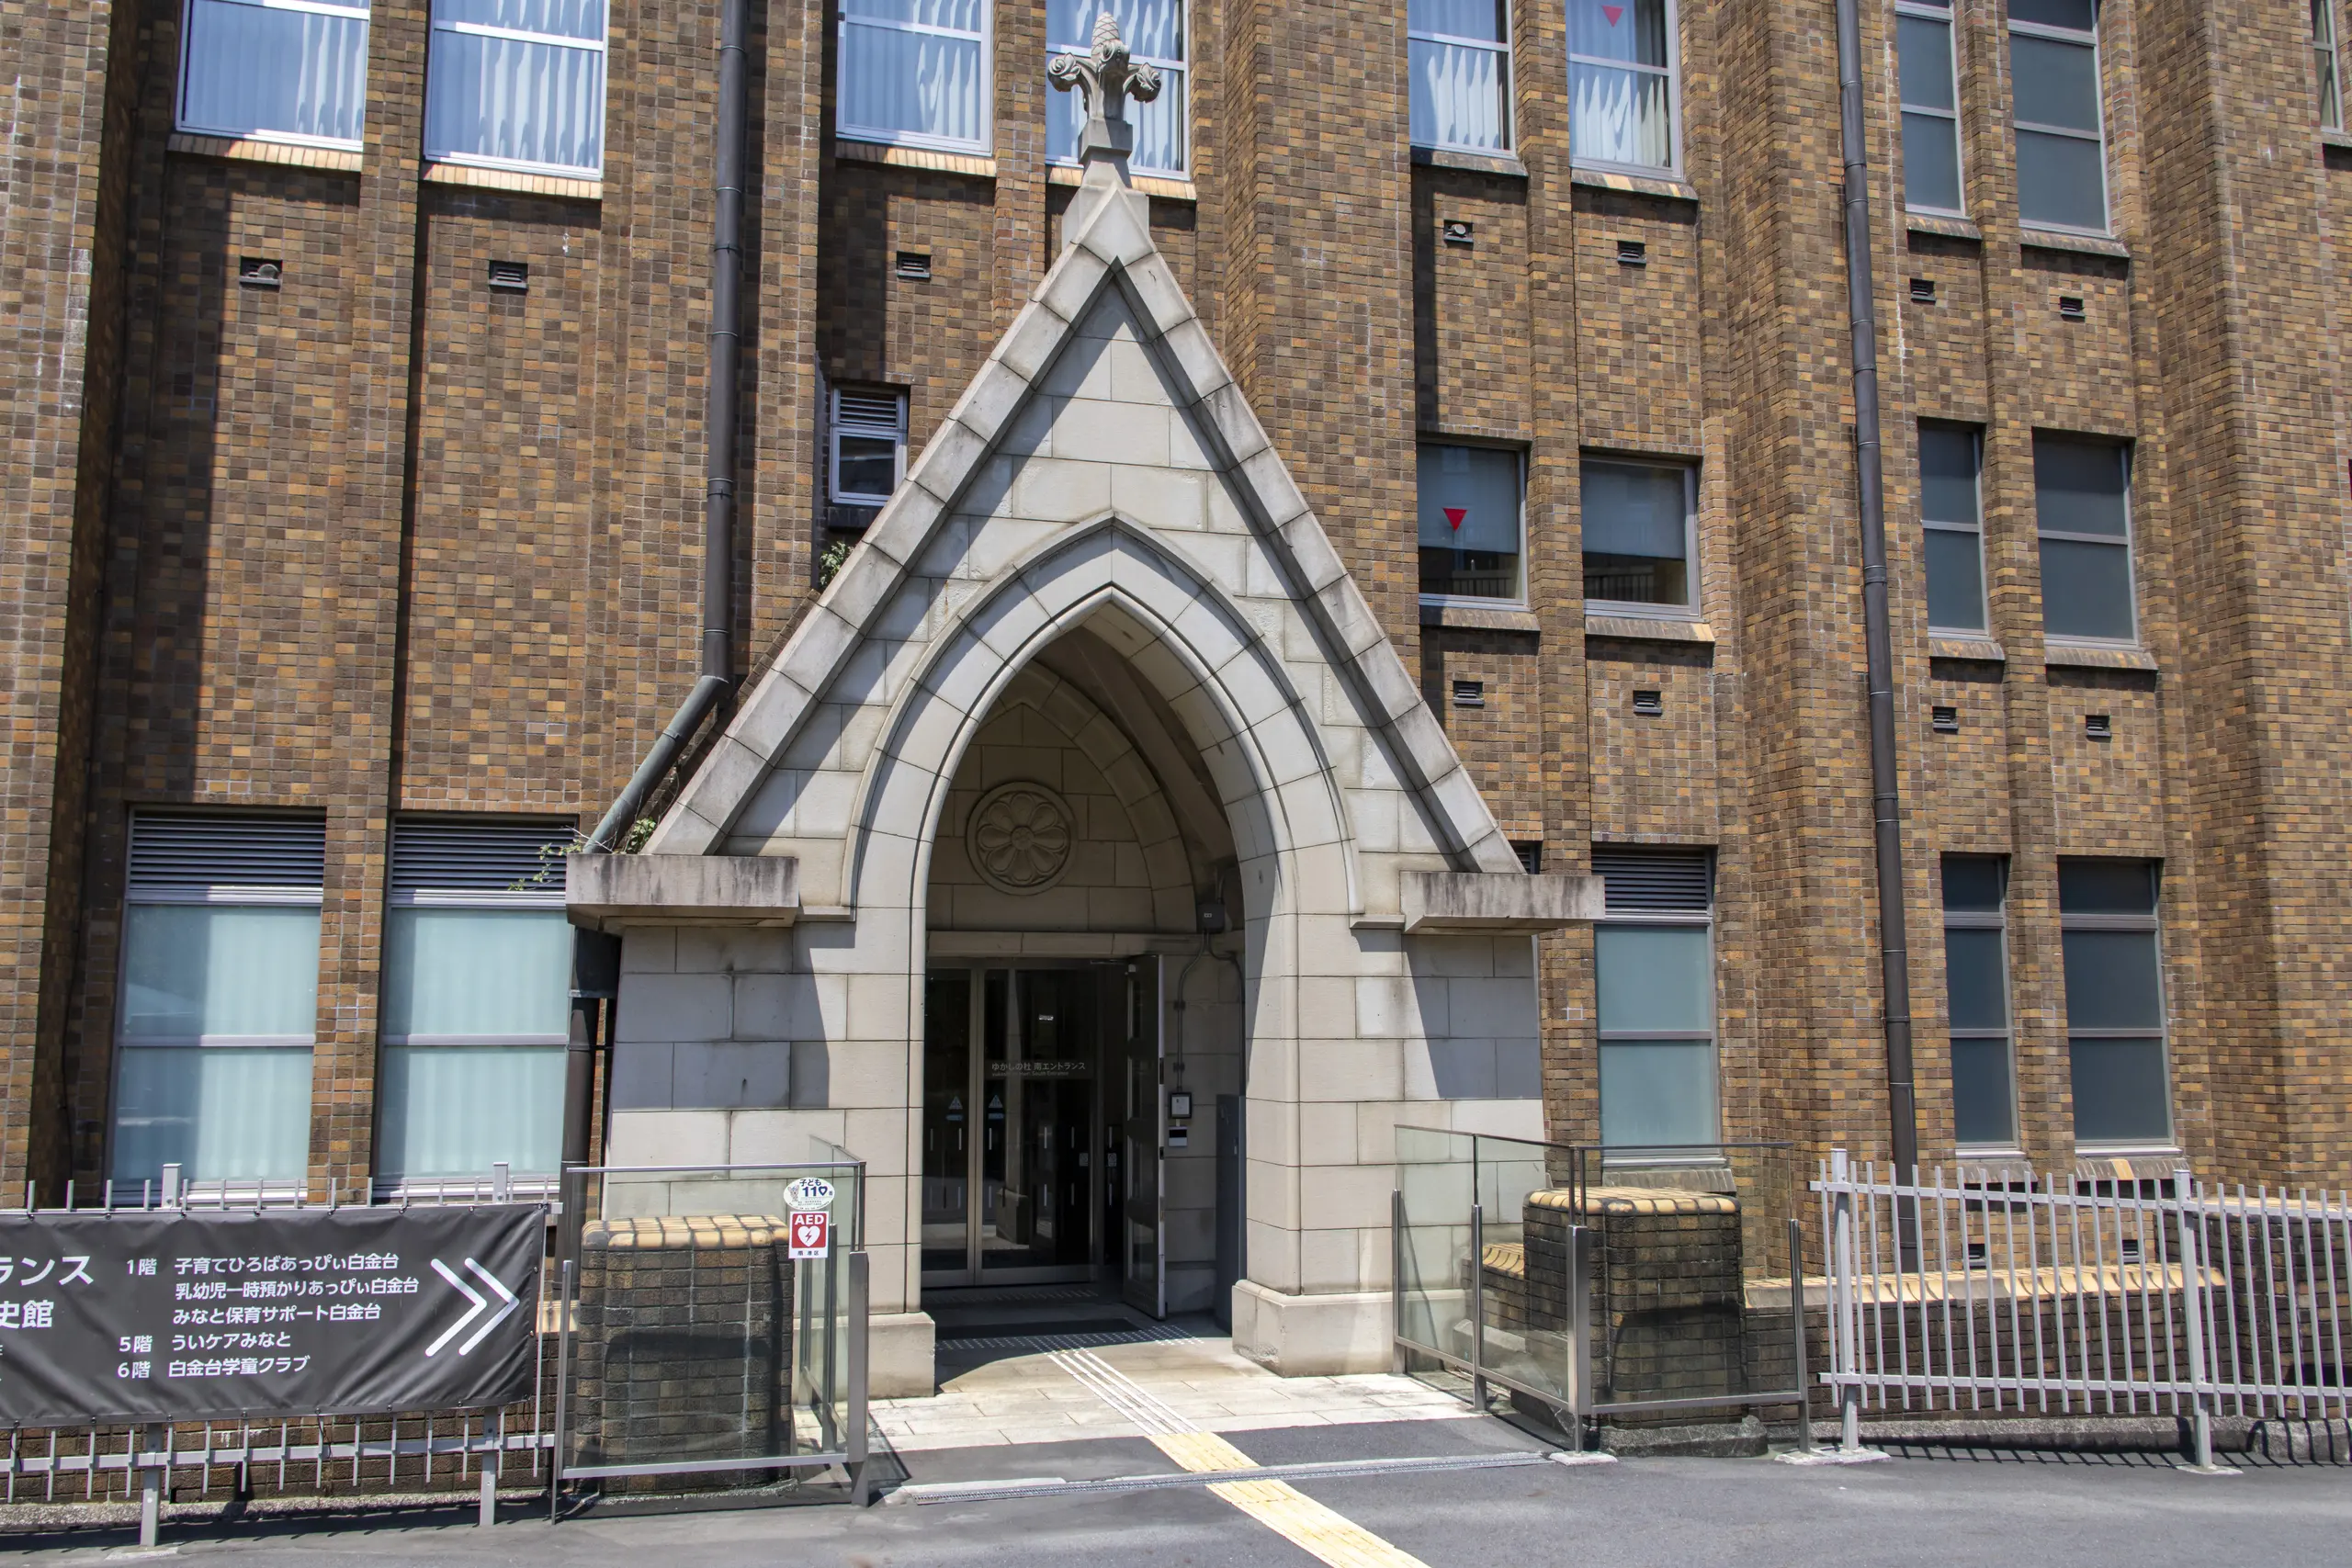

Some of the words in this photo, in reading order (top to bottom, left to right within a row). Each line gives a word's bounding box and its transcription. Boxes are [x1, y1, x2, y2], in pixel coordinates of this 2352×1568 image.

[991, 1062, 1032, 1071] ゆかしの杜
[1034, 1061, 1086, 1070] 南エントランス
[799, 1179, 821, 1187] 子ども
[795, 1214, 824, 1225] AED
[127, 1258, 157, 1276] 1階
[175, 1253, 399, 1275] 子育てひろばあっぴぃ白金台
[175, 1277, 419, 1301] 乳幼児一時預かりあっぴぃ白金台
[173, 1303, 381, 1325] みなと保育サポート白金台
[119, 1336, 153, 1353] 5階
[172, 1332, 291, 1351] ういケアみなと
[118, 1361, 151, 1378] 6階
[169, 1355, 311, 1377] 白金台学童クラブ
